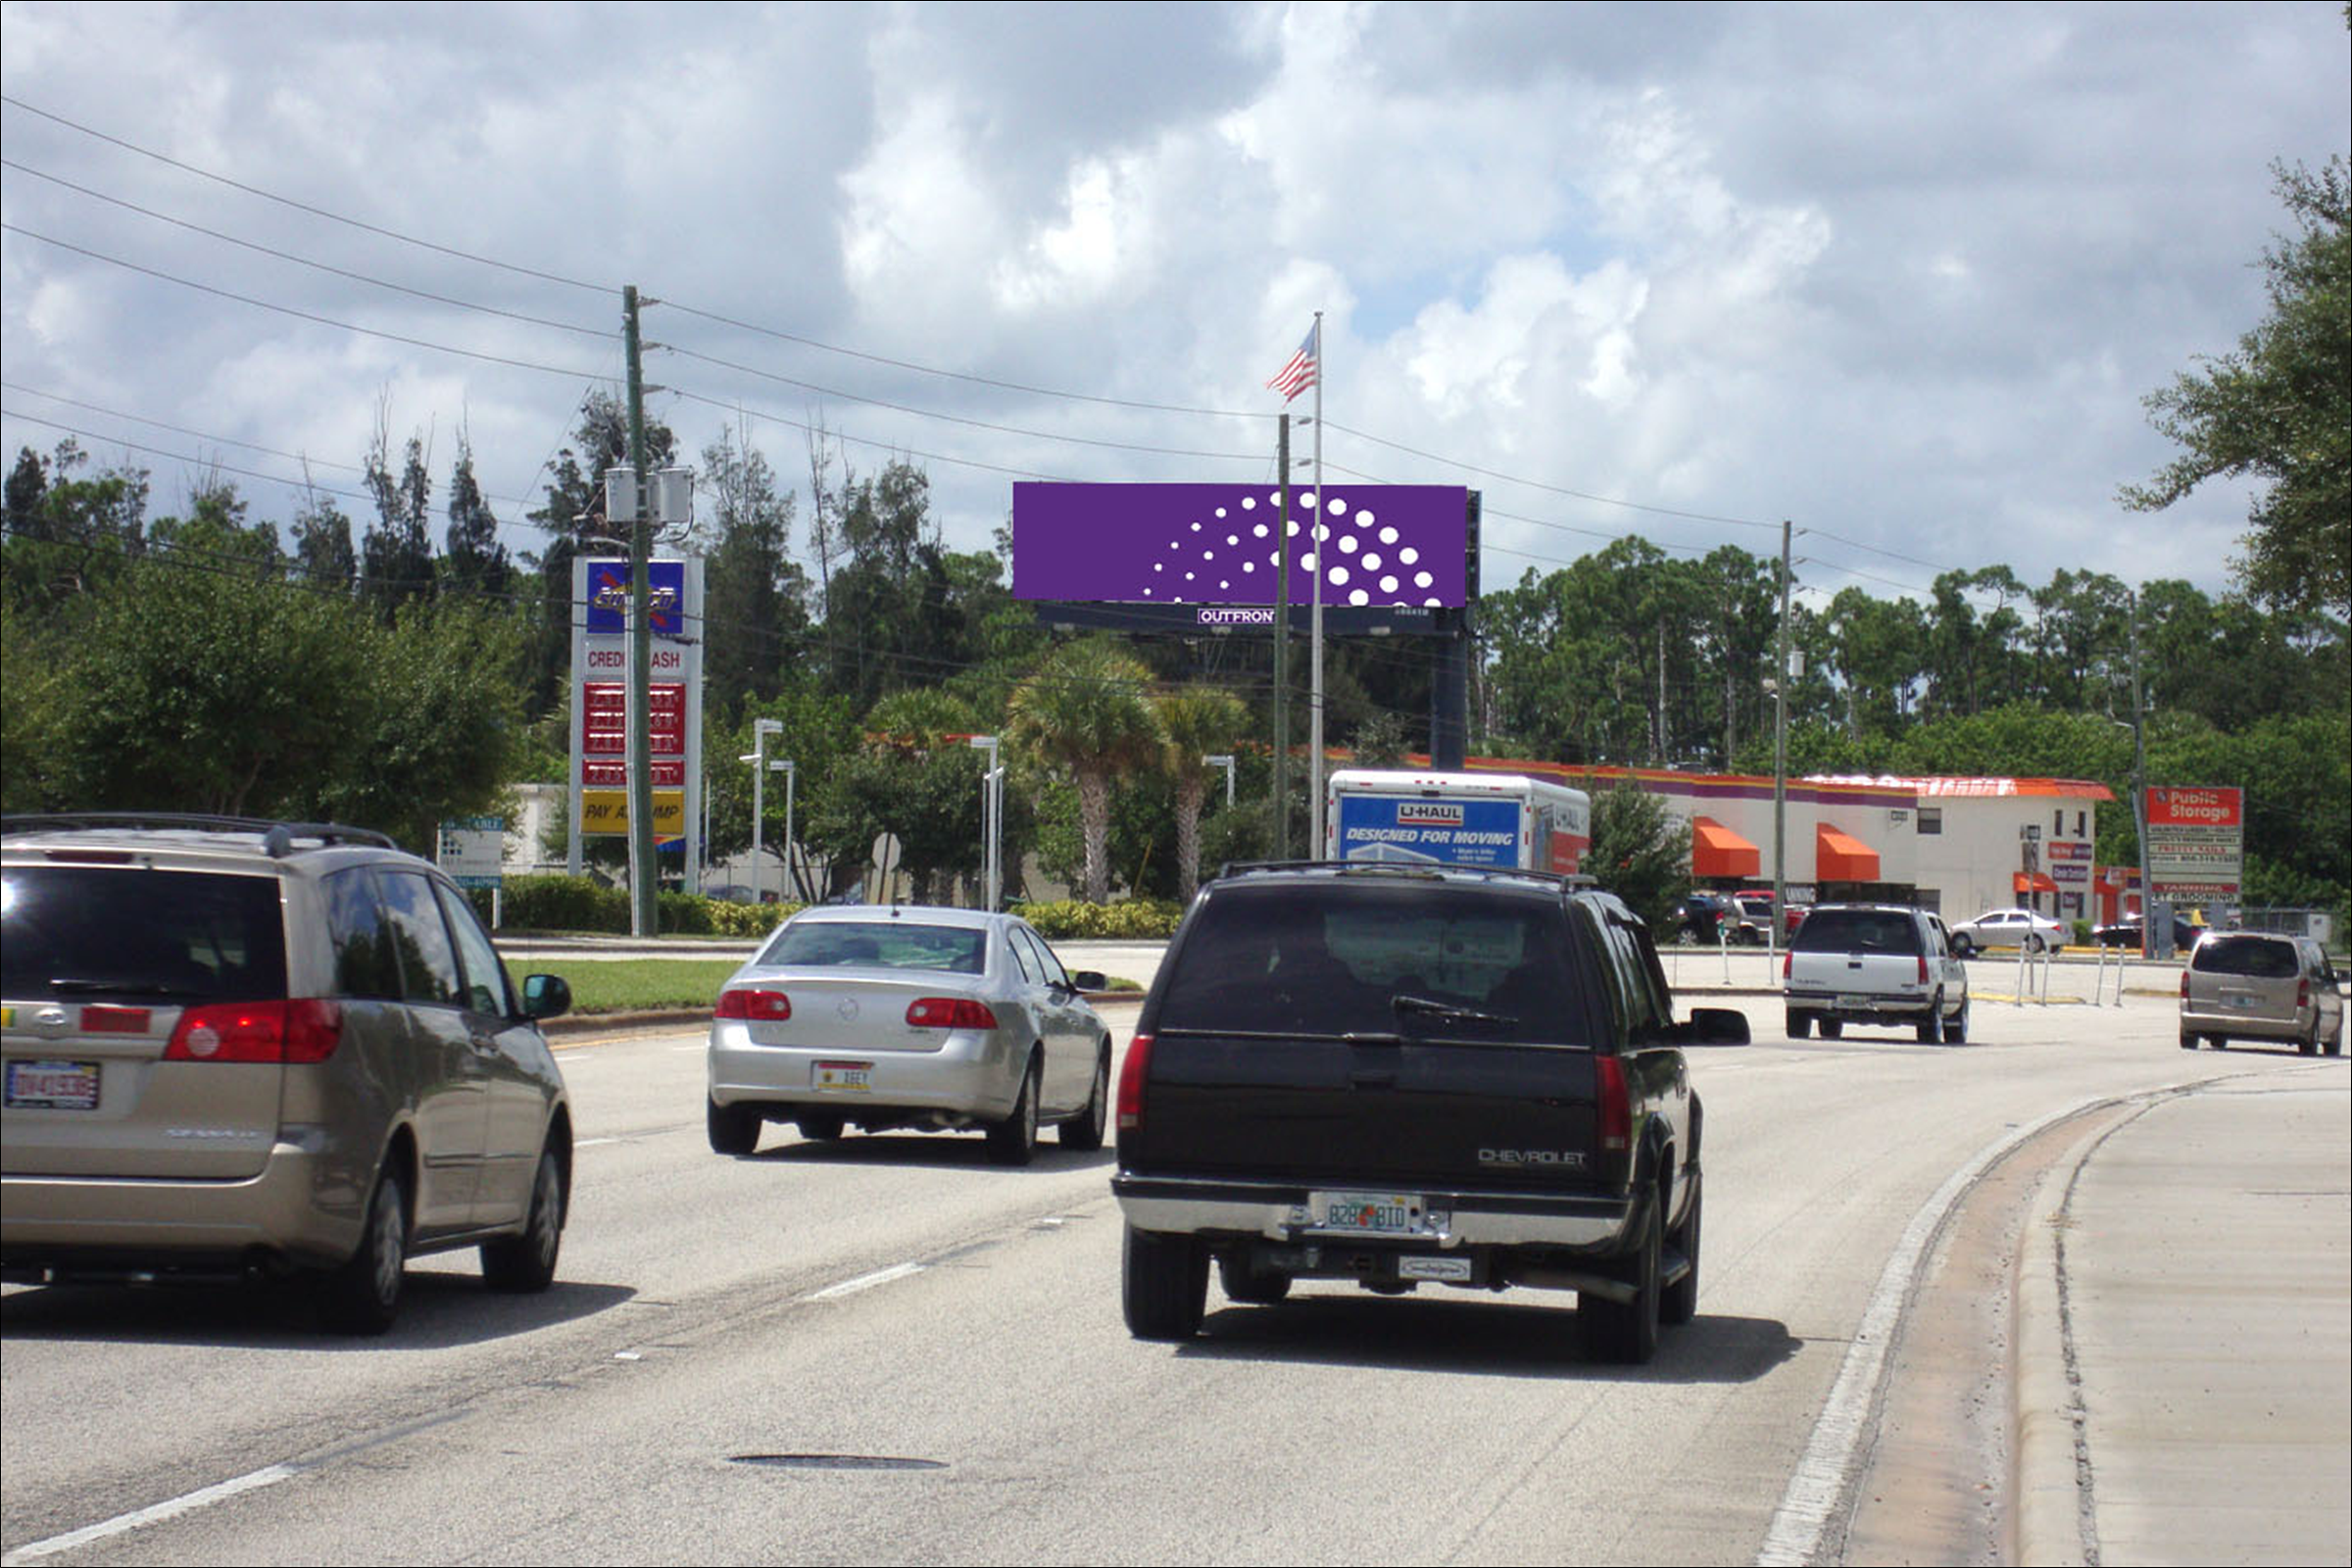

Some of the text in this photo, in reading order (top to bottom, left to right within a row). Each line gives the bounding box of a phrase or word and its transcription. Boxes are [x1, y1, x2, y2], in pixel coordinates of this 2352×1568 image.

[595, 591, 674, 607] SUCO
[1201, 611, 1274, 621] OUTFRON
[588, 651, 680, 668] CREDI ASH
[2171, 791, 2218, 804] Public
[585, 805, 611, 818] PAY
[1399, 806, 1461, 819] U-HAUL
[2171, 804, 2230, 821] Storage
[1347, 827, 1514, 846] DESIGNED FOR MOVING
[2172, 893, 2235, 903] GROOMING
[1478, 1148, 1587, 1165] CHEVROLET
